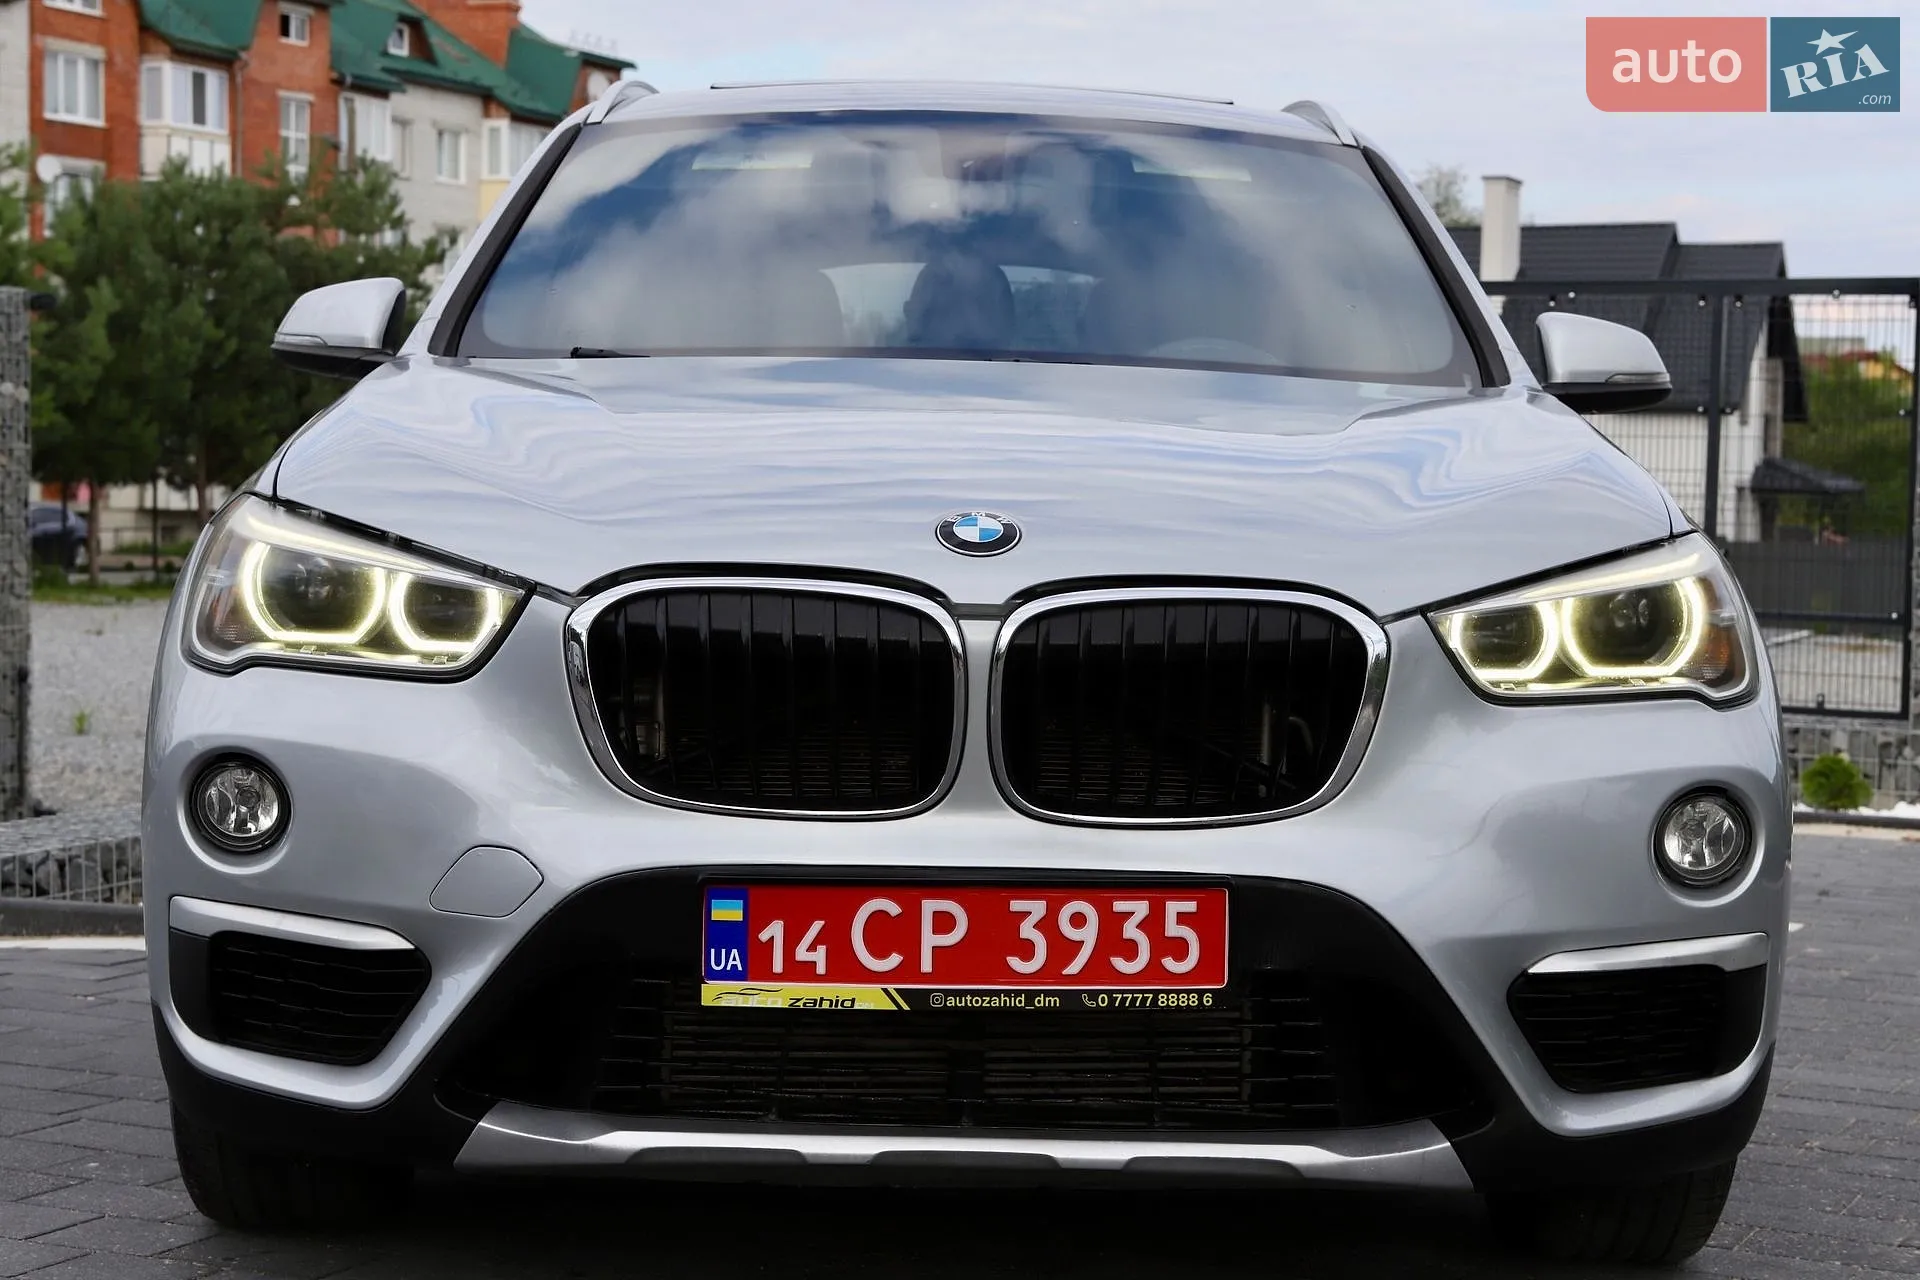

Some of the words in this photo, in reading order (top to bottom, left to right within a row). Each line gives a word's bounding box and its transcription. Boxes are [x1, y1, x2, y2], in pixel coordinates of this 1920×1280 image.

[758, 920, 827, 975] 14
[851, 898, 968, 973] CP
[1006, 900, 1200, 975] 3935
[710, 948, 743, 971] UA
[788, 995, 856, 1009] zahid
[946, 993, 1060, 1009] autozahid_dm
[1112, 994, 1153, 1007] 7777
[1157, 994, 1198, 1007] 8888
[1202, 993, 1213, 1007] 6
